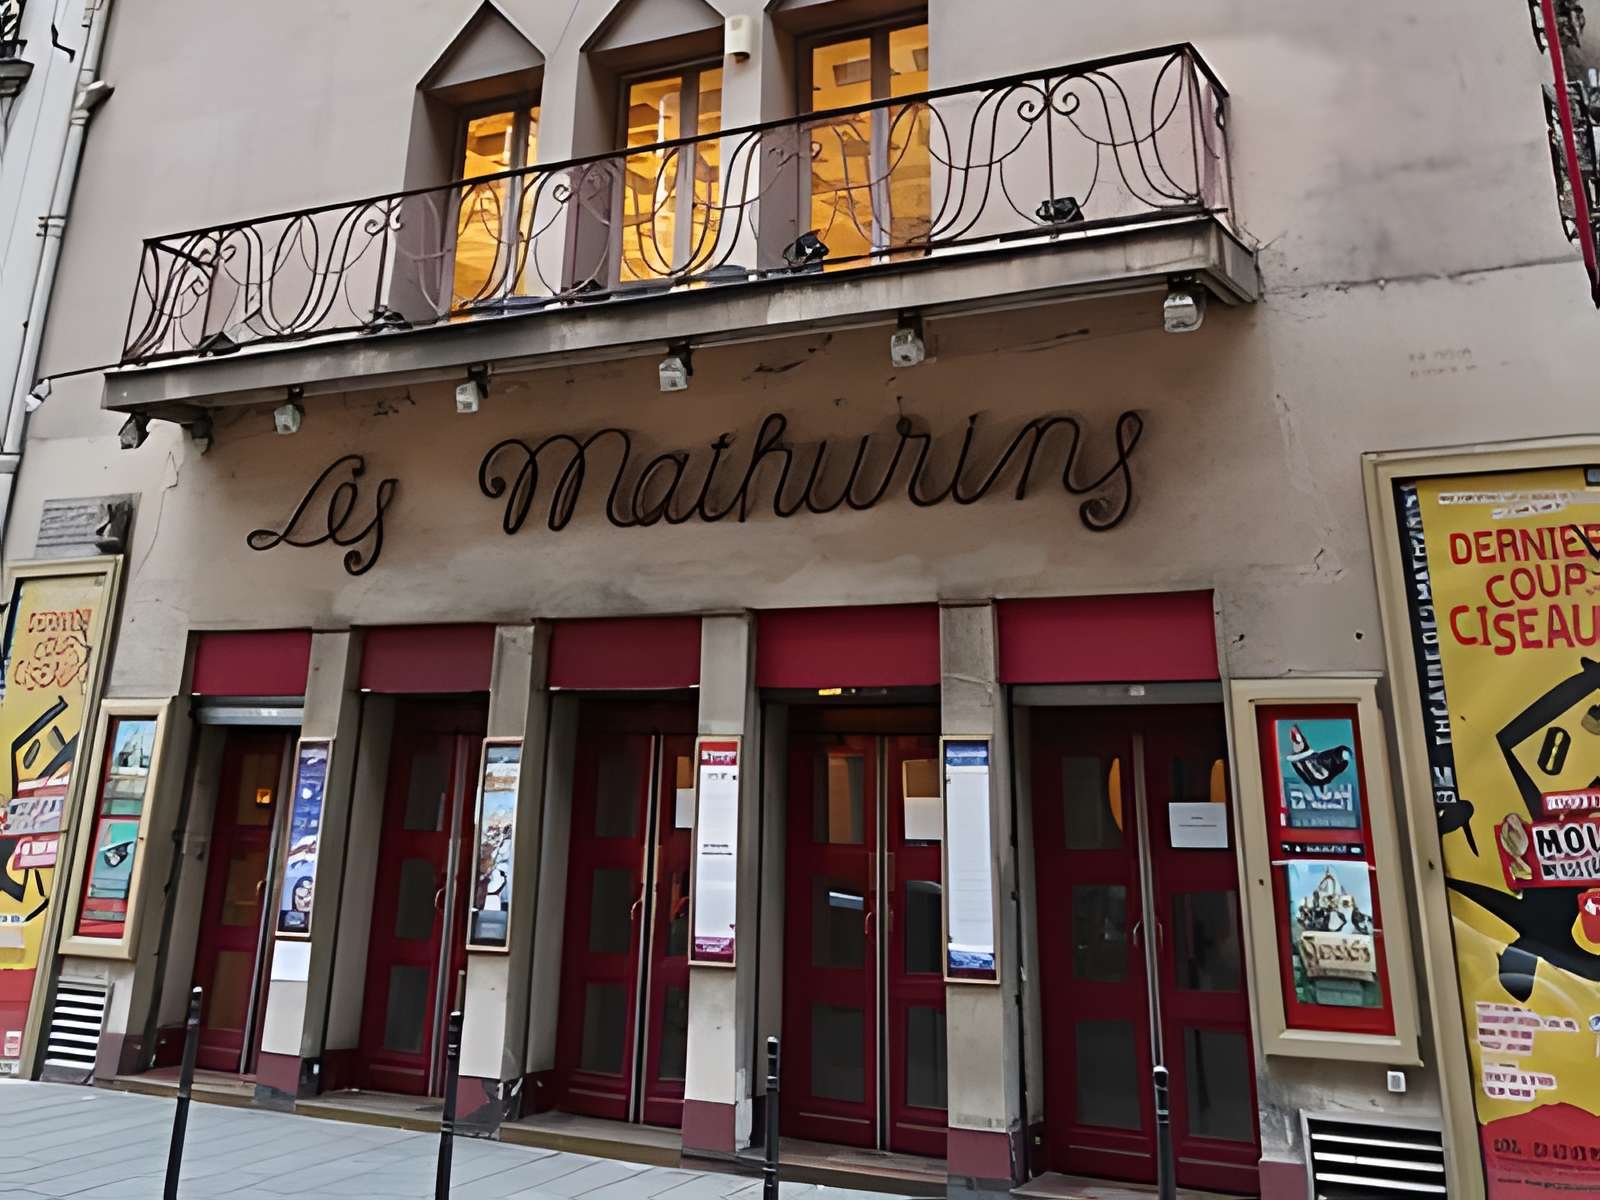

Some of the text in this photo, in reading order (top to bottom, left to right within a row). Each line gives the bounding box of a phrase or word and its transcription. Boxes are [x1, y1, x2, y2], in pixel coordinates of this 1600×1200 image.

[246, 409, 1144, 576] Les Mathurins
[1486, 563, 1586, 608] COUP
